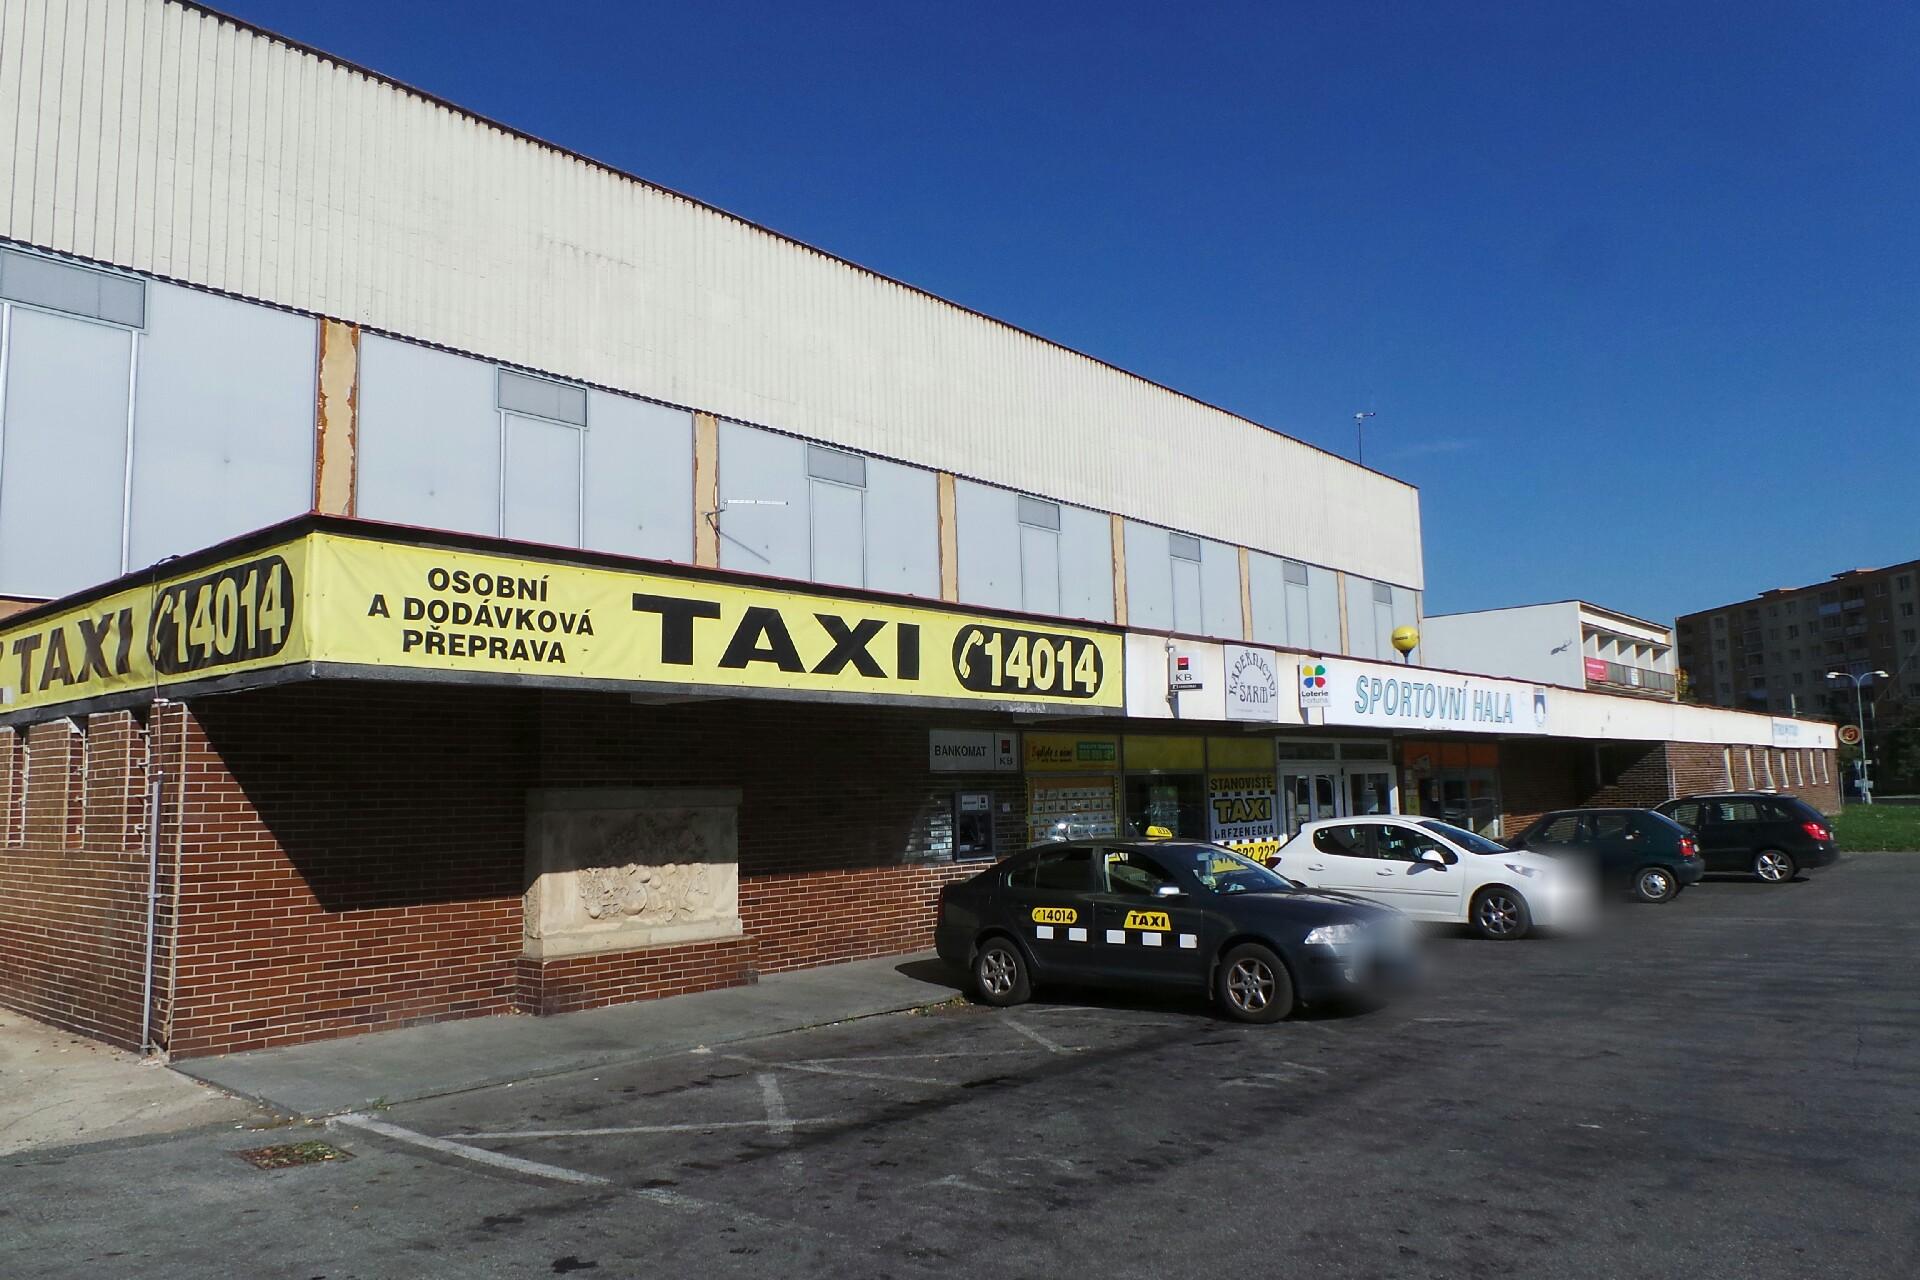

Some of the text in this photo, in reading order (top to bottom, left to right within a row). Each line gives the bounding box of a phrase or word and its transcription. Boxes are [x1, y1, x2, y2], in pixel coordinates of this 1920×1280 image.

[428, 568, 549, 602] OSOBNÍ
[172, 563, 285, 664] 14014
[368, 594, 594, 636] A DODÁVKOVÁ
[13, 607, 133, 694] TAXI
[402, 625, 566, 664] PŘEPRAVA
[632, 592, 920, 680] TAXI
[985, 632, 1097, 693] 14014
[1175, 674, 1193, 682] KB
[1354, 675, 1513, 723] SPORTOVNÍ HALA
[934, 745, 987, 758] BANKOMAT
[1213, 796, 1273, 824] TAXI
[1042, 909, 1074, 922] 14014
[1130, 914, 1166, 927] TAXI
